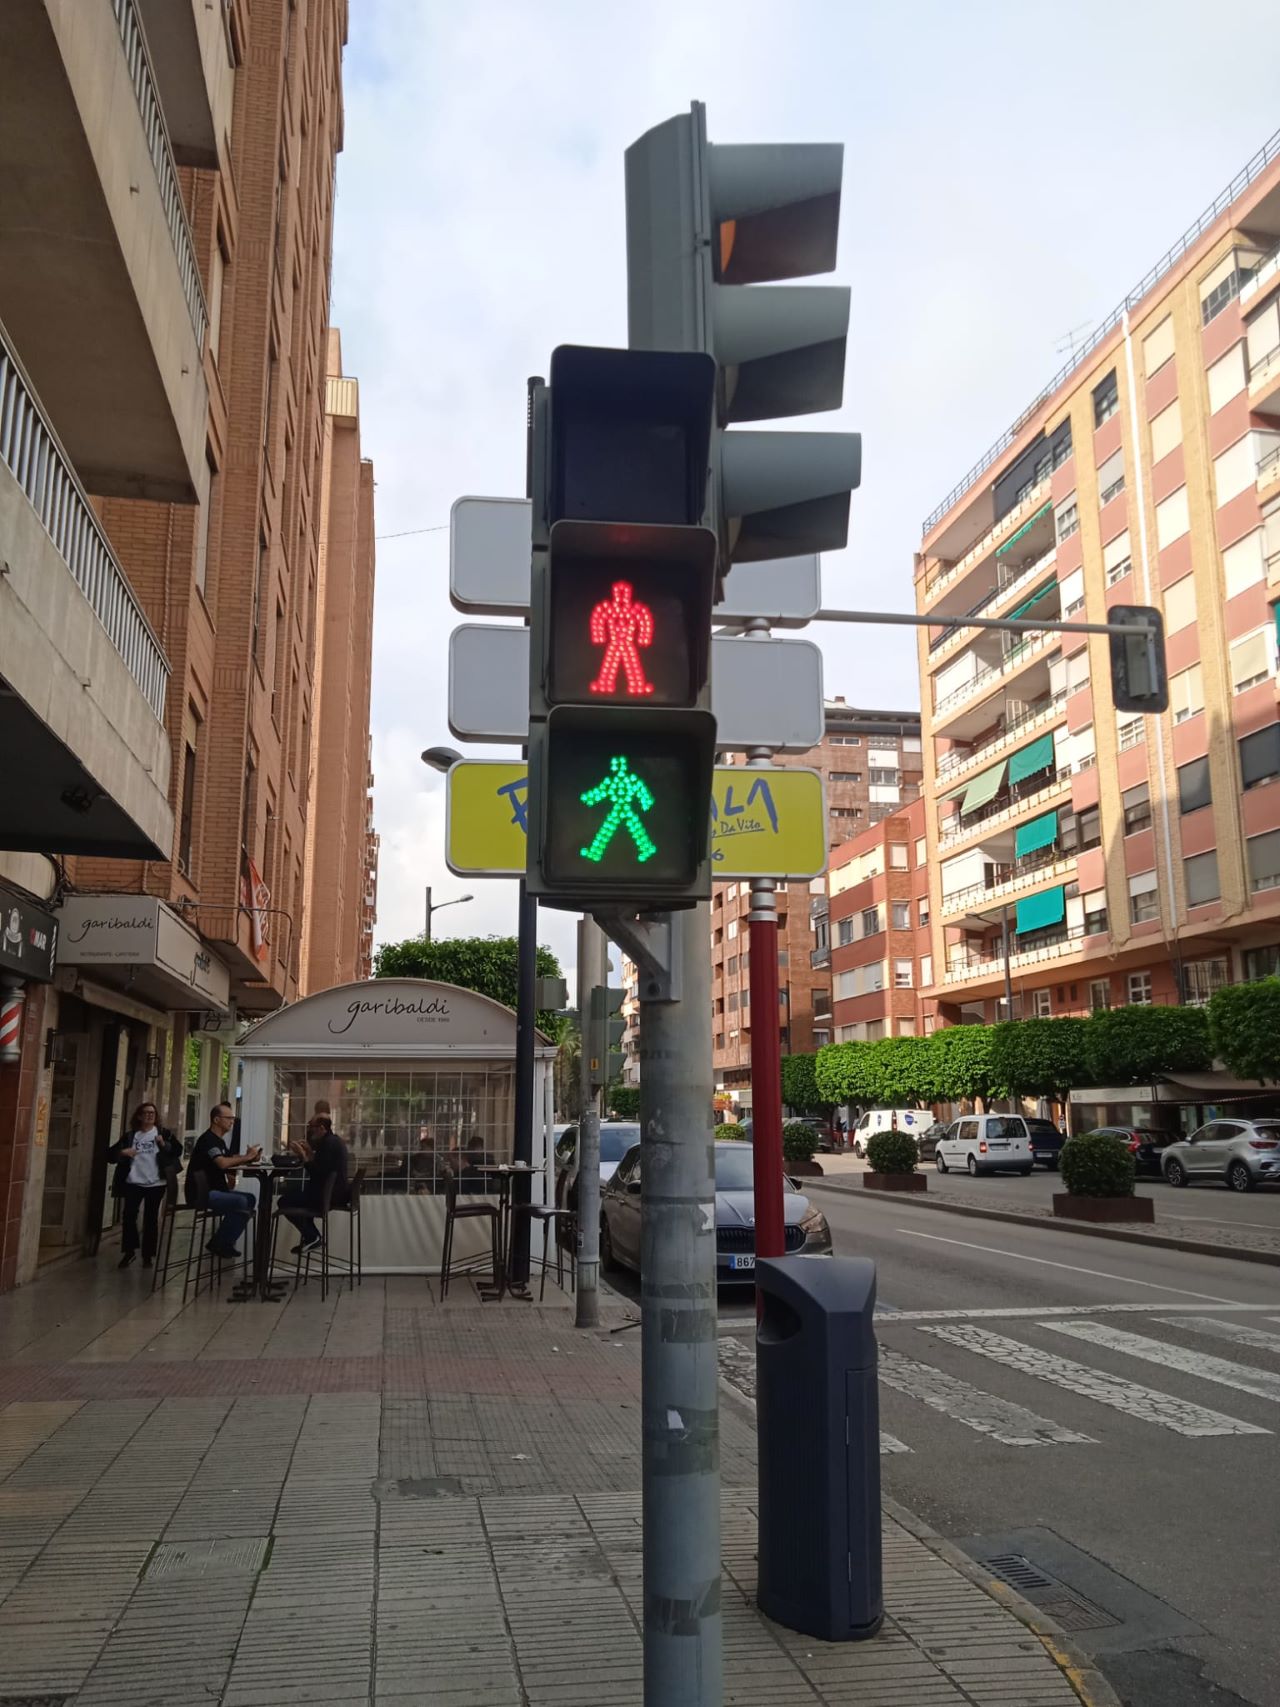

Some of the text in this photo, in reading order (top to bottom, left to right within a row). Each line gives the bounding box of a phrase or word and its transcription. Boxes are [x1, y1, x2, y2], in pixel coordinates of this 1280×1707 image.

[737, 818, 761, 832] Vito
[67, 916, 154, 942] garibaldi
[327, 997, 450, 1034] garibaldi
